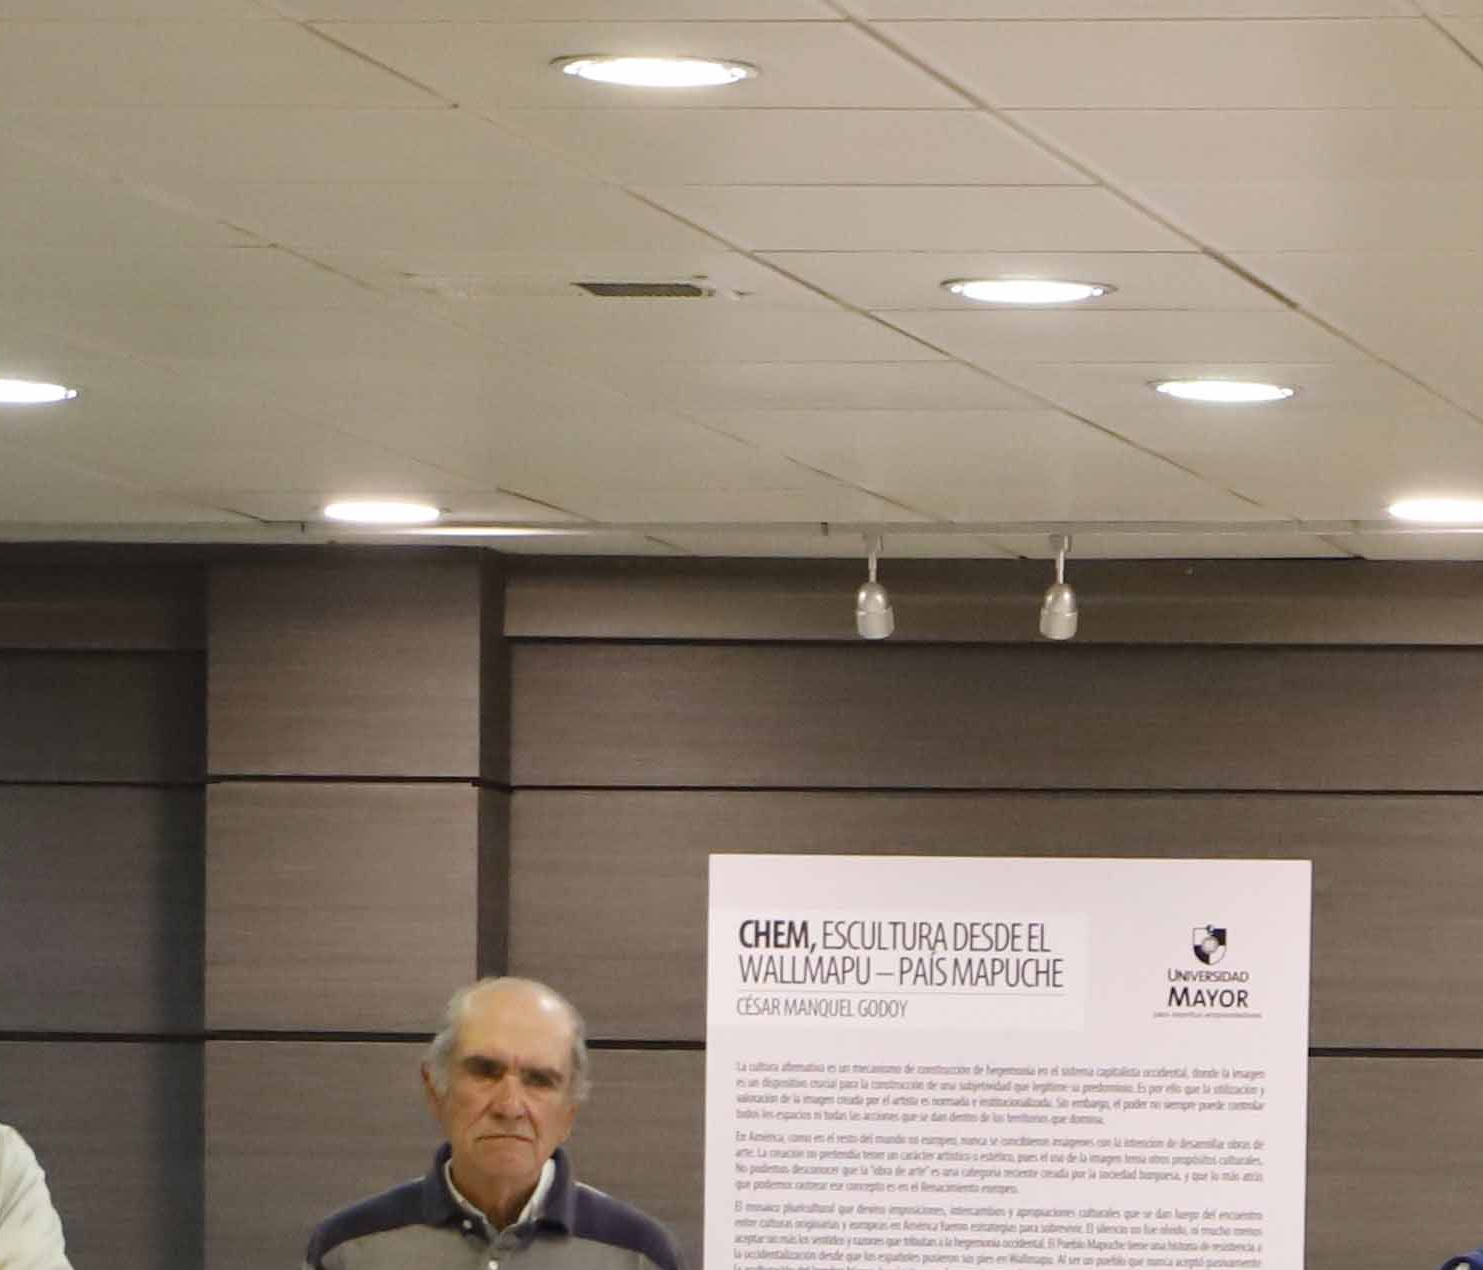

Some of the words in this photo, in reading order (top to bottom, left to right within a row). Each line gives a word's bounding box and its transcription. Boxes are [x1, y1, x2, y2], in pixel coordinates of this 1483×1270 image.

[739, 920, 816, 952] CHEM,
[822, 921, 948, 951] ESCULTURA
[954, 922, 1023, 952] DESDE
[1028, 923, 1052, 952] EL
[739, 954, 870, 985] WALLMAPU
[899, 951, 948, 986] PAÍS
[952, 957, 1064, 988] MAPUCHE
[1168, 968, 1250, 983] UNIVERSIDAD
[736, 994, 781, 1016] CÉSAR
[784, 998, 855, 1018] MANQUEL
[858, 999, 909, 1018] GODOY
[1168, 986, 1249, 1008] MAYOR
